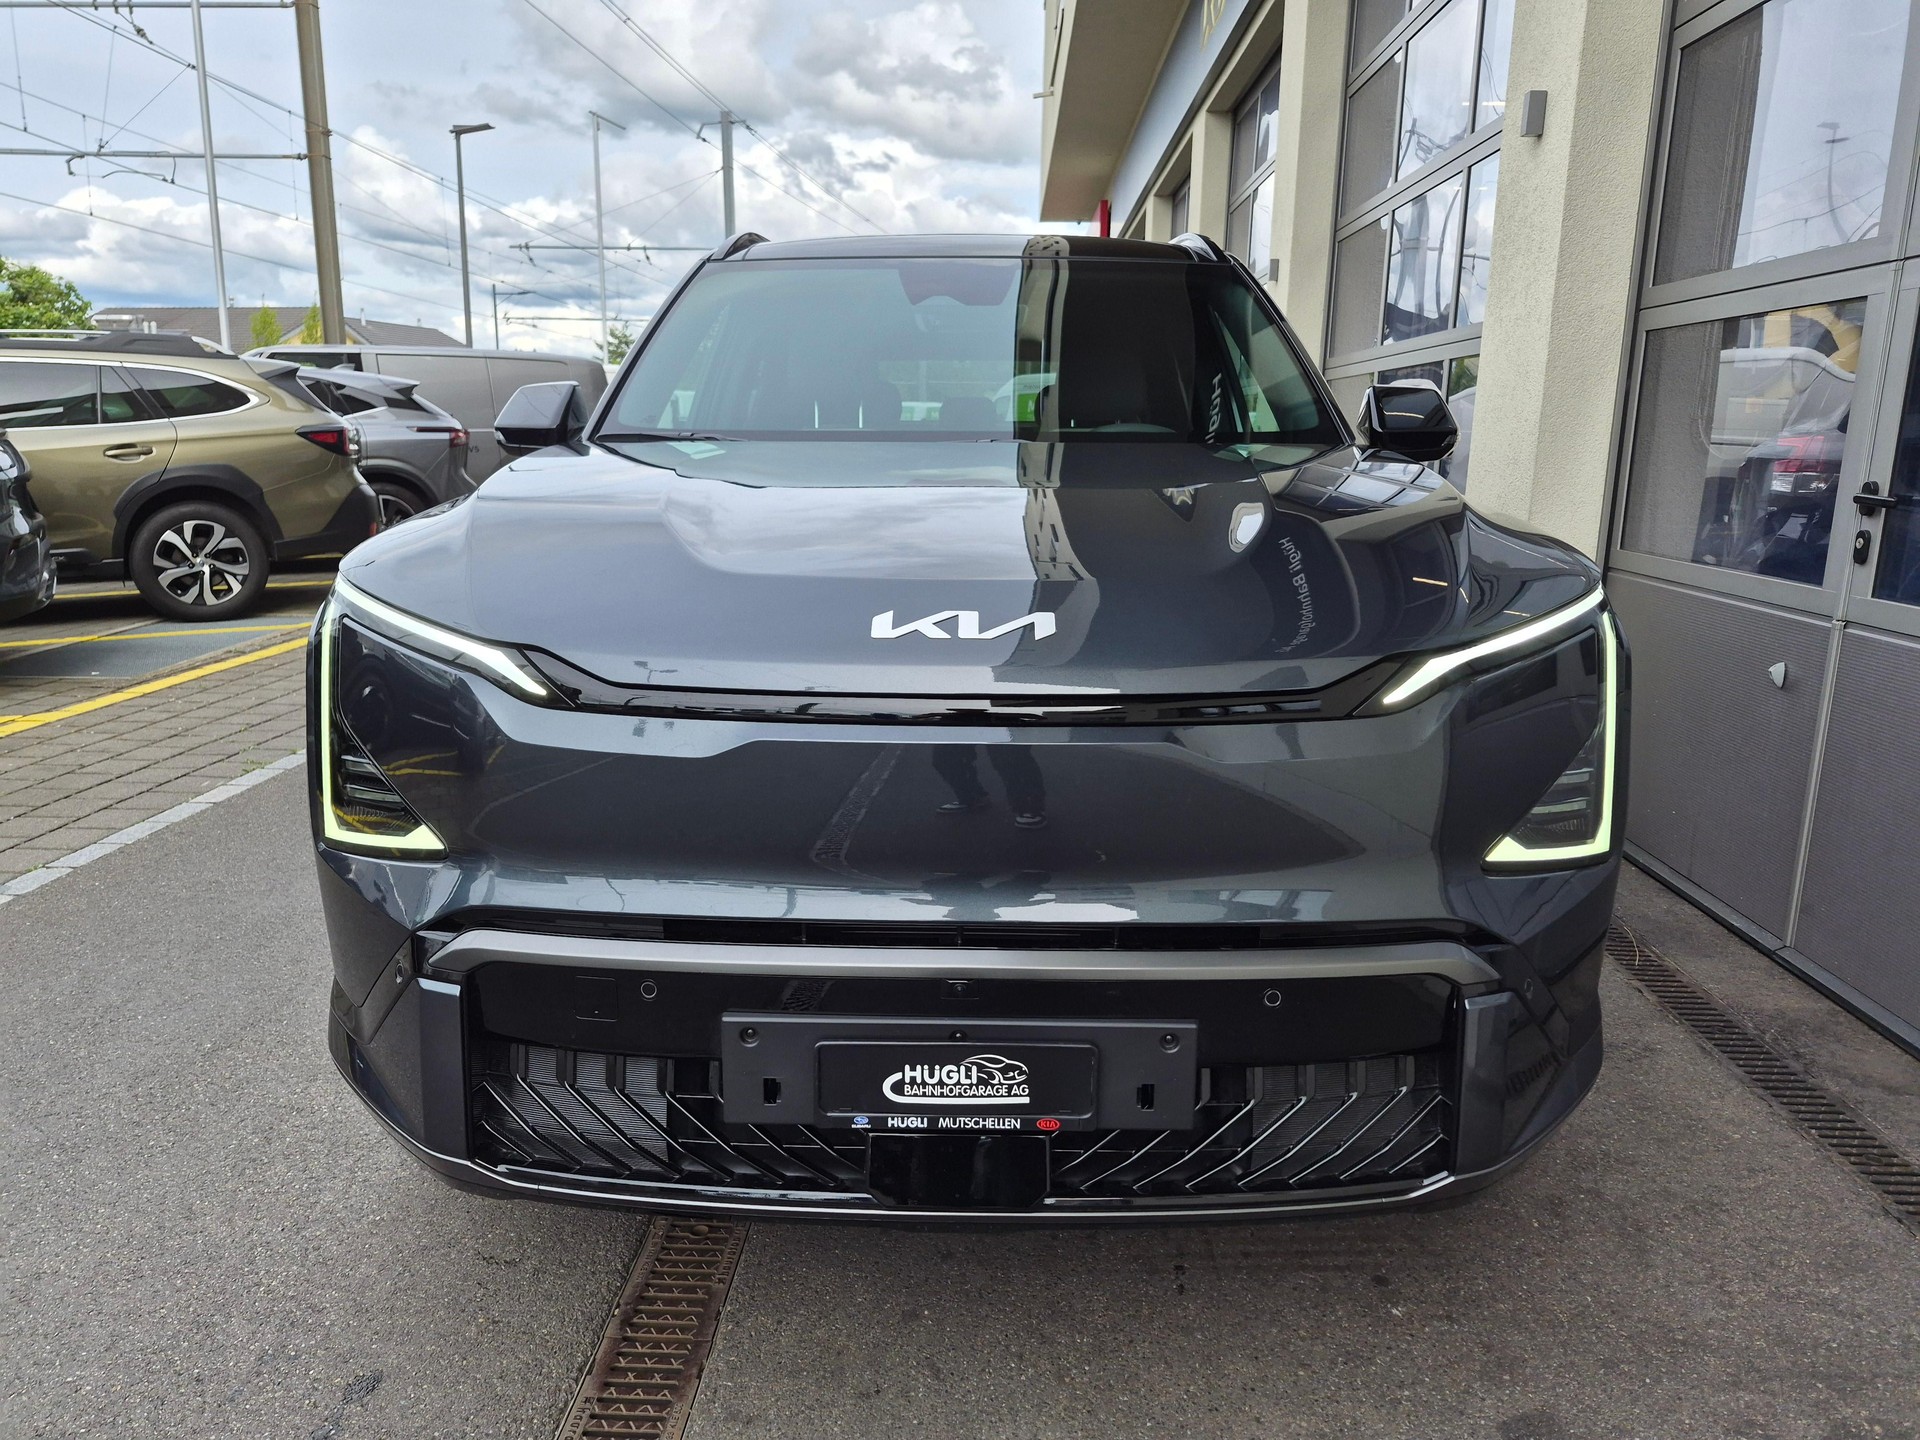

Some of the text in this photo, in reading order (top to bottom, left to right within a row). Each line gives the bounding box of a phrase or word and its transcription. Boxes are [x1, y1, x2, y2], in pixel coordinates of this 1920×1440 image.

[904, 1064, 977, 1085] HÜGLI
[904, 1085, 1029, 1096] BAHNHOFGARAGE AG
[938, 1117, 1020, 1129] MUTSCHELLEN
